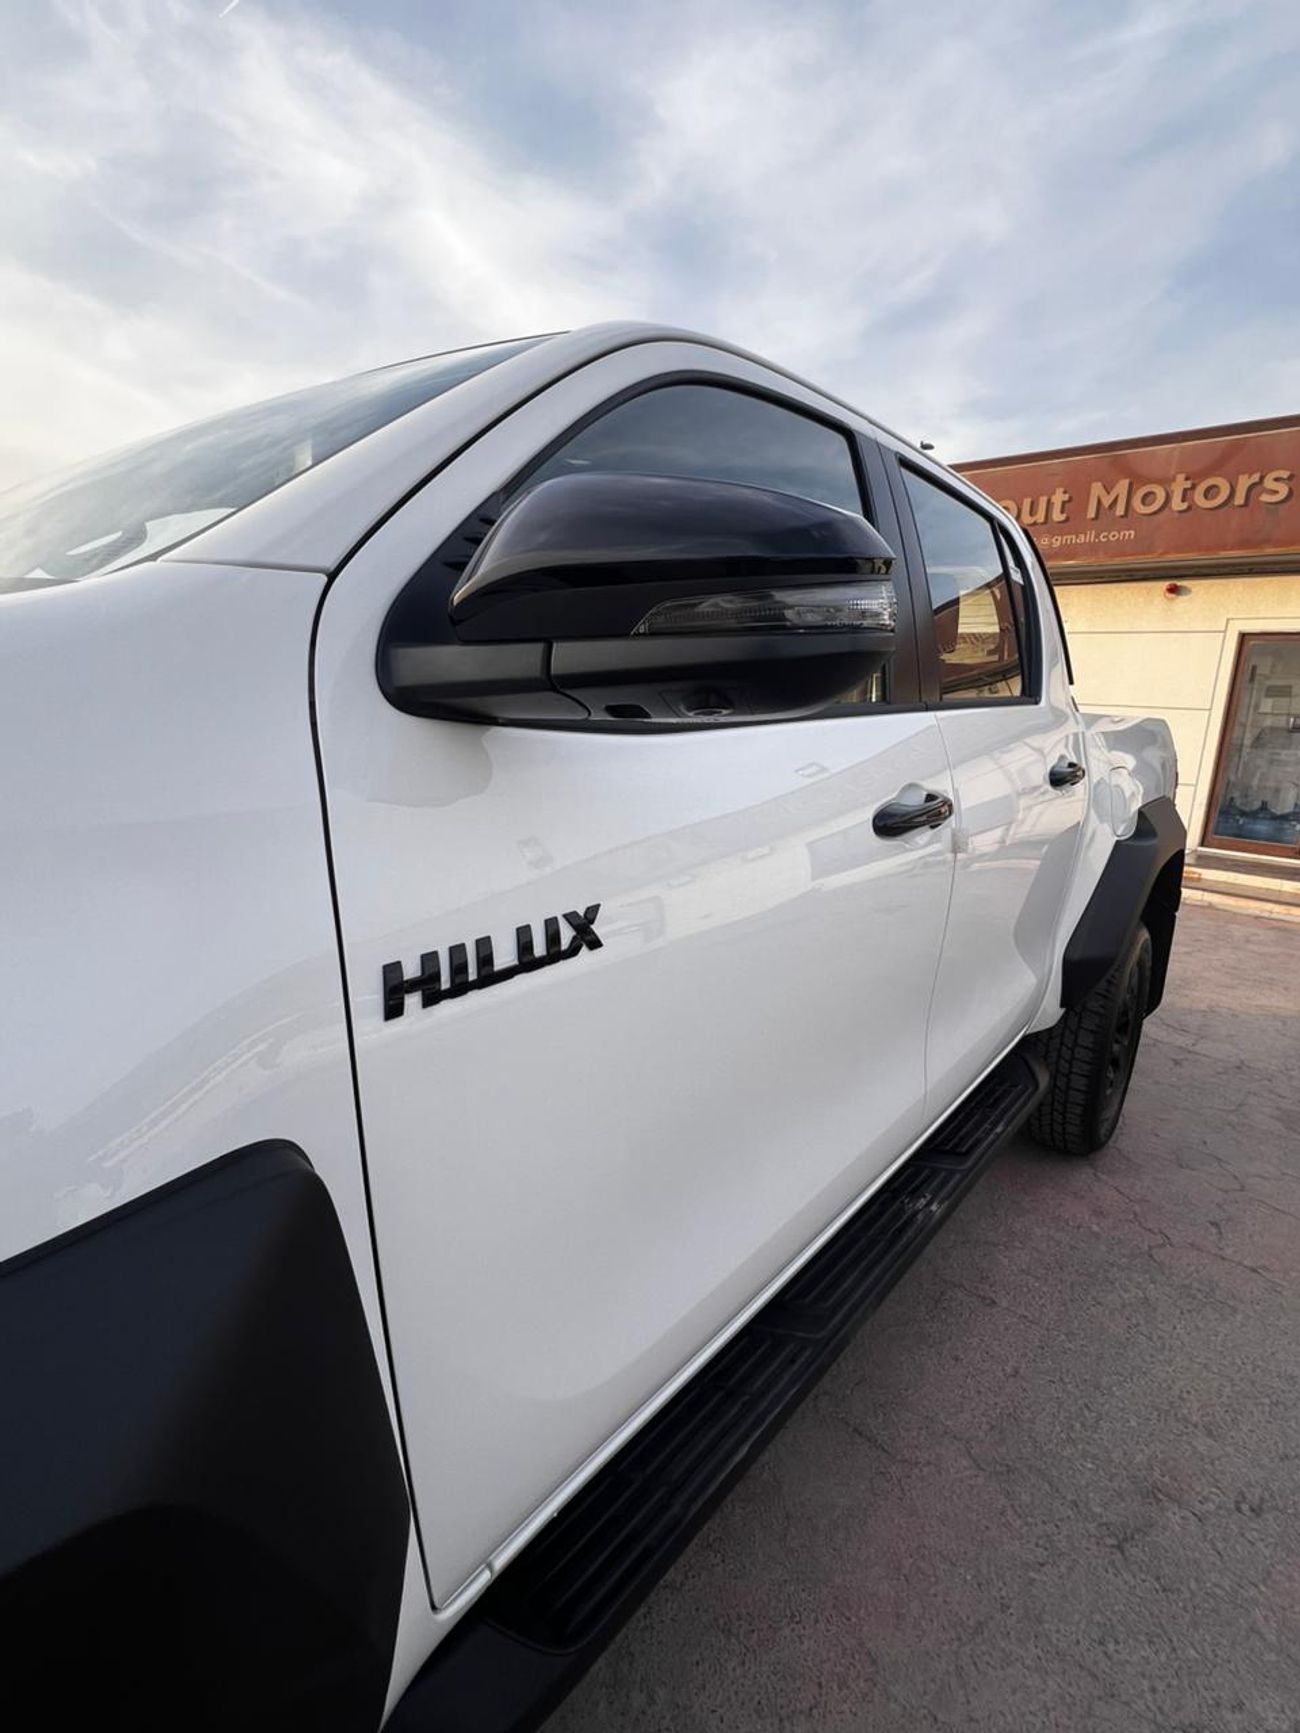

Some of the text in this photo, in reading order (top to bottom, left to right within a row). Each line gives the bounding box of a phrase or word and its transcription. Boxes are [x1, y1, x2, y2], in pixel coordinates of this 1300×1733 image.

[1087, 469, 1291, 519] Motors
[1033, 528, 1135, 547] @gmail.com
[382, 903, 604, 1022] HILUX
